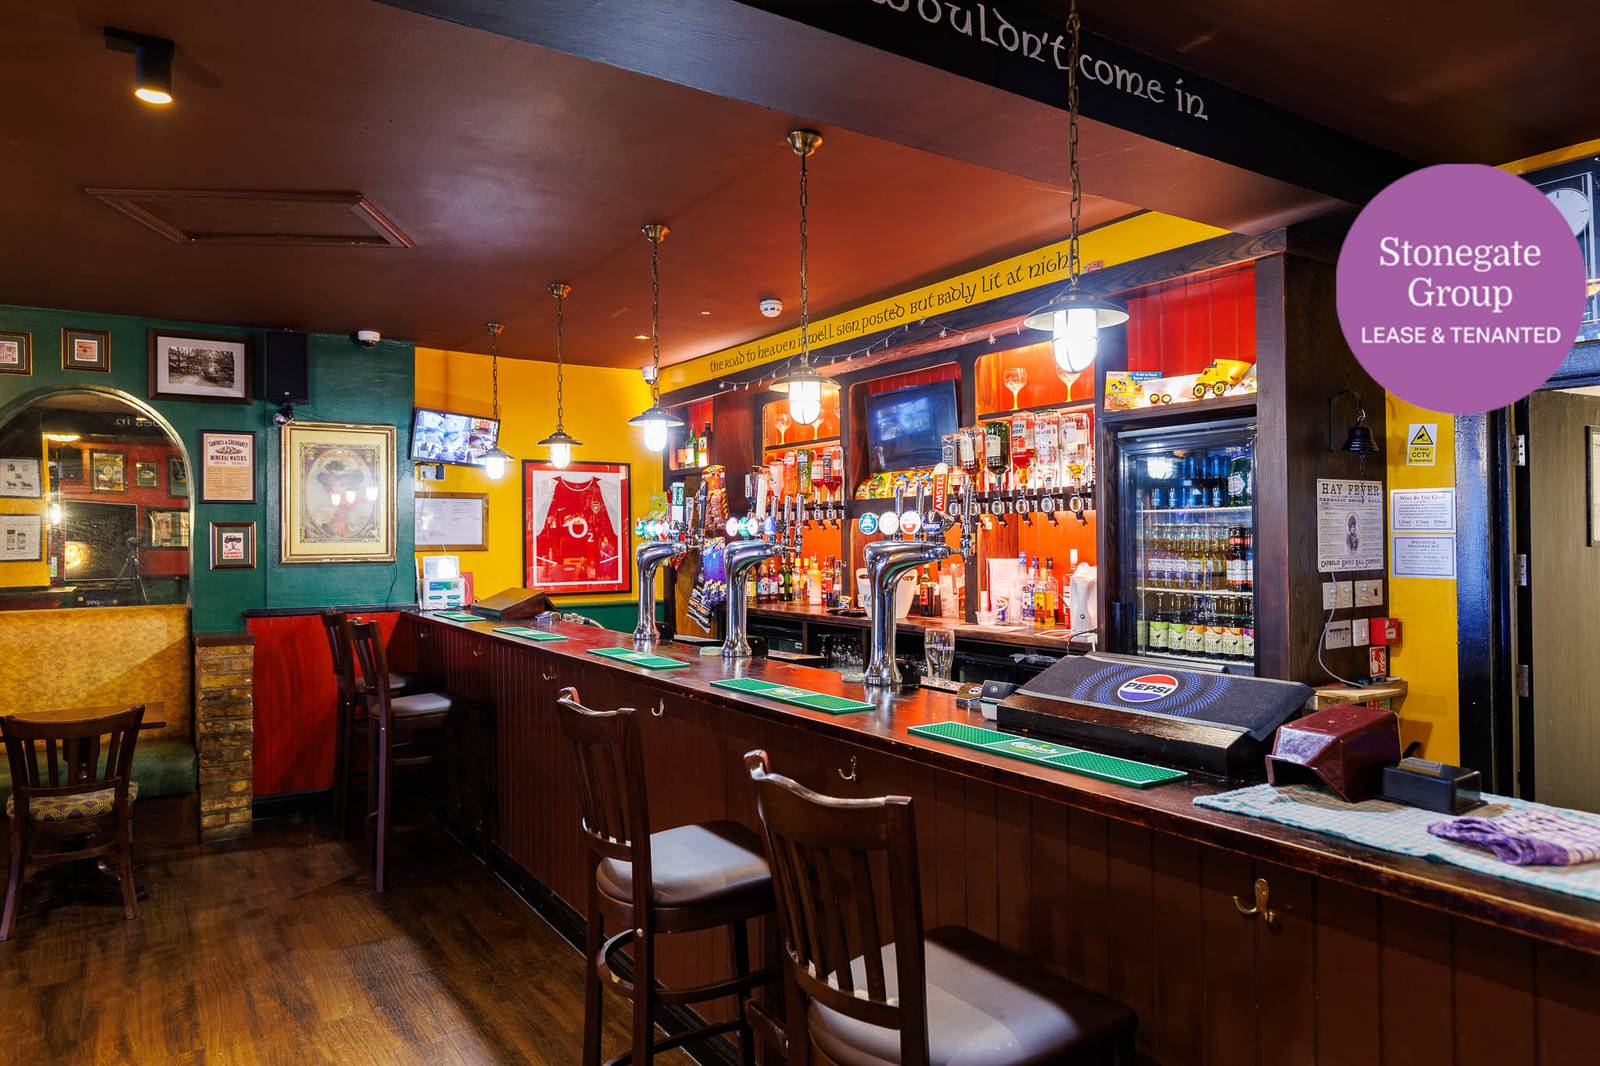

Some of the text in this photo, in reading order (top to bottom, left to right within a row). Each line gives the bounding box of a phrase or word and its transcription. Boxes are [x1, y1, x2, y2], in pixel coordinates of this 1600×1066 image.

[1078, 53, 1166, 103] come
[1174, 77, 1209, 121] in
[710, 360, 724, 373] the
[746, 350, 756, 362] to
[757, 338, 796, 359] heaven
[808, 323, 834, 345] well
[1006, 266, 1024, 284] at
[1028, 252, 1076, 279] nigh
[935, 474, 945, 510] AMSTEL
[1321, 483, 1380, 497] HAY FEVER
[1124, 682, 1172, 694] PEPSI
